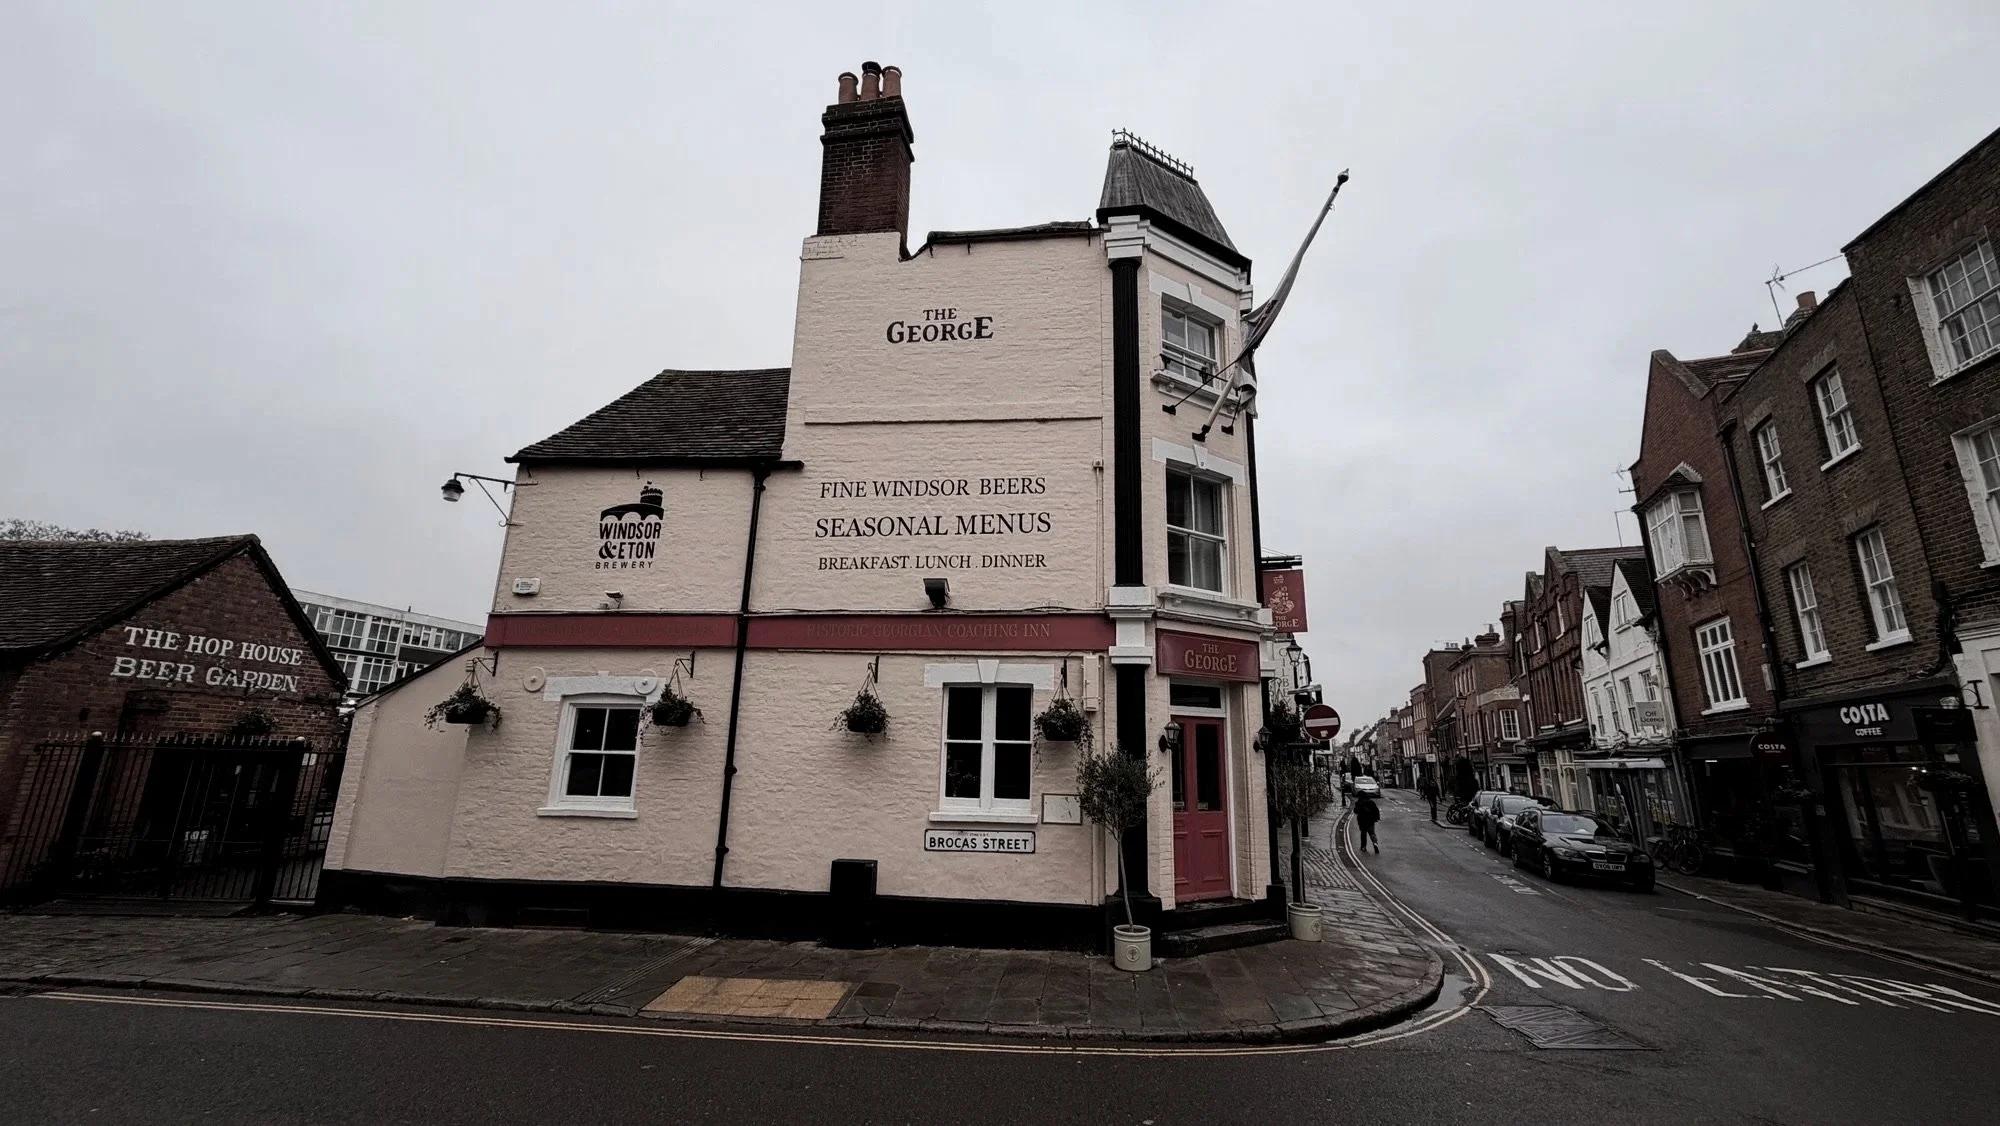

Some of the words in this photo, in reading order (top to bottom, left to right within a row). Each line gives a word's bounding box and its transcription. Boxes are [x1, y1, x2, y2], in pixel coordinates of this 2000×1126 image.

[923, 307, 957, 321] THE
[886, 316, 994, 344] GEORGE
[820, 481, 867, 498] FINE
[872, 479, 970, 497] WINDSOR
[979, 477, 1046, 495] BEERS
[599, 522, 662, 539] WINDSOR
[815, 515, 949, 538] SEASONAL
[954, 512, 1051, 536] MENUS
[595, 560, 653, 569] BREWERY
[981, 554, 1047, 569] DINNER
[872, 623, 942, 637] GEORGIAN
[947, 623, 1018, 637] COACHING
[1024, 623, 1050, 637] INN
[124, 626, 181, 650] THE
[185, 634, 234, 657] HOP
[239, 642, 304, 666] HOUSE
[1202, 643, 1219, 654] THE
[1184, 649, 1237, 673] GEORGE
[110, 656, 196, 683] BEER
[205, 666, 301, 692] GARDEN
[1840, 703, 1890, 725] COSTA
[1855, 727, 1882, 736] COFFEE
[929, 837, 977, 849] BROCAS
[983, 838, 1029, 850] STREET
[1487, 953, 1640, 992] NO
